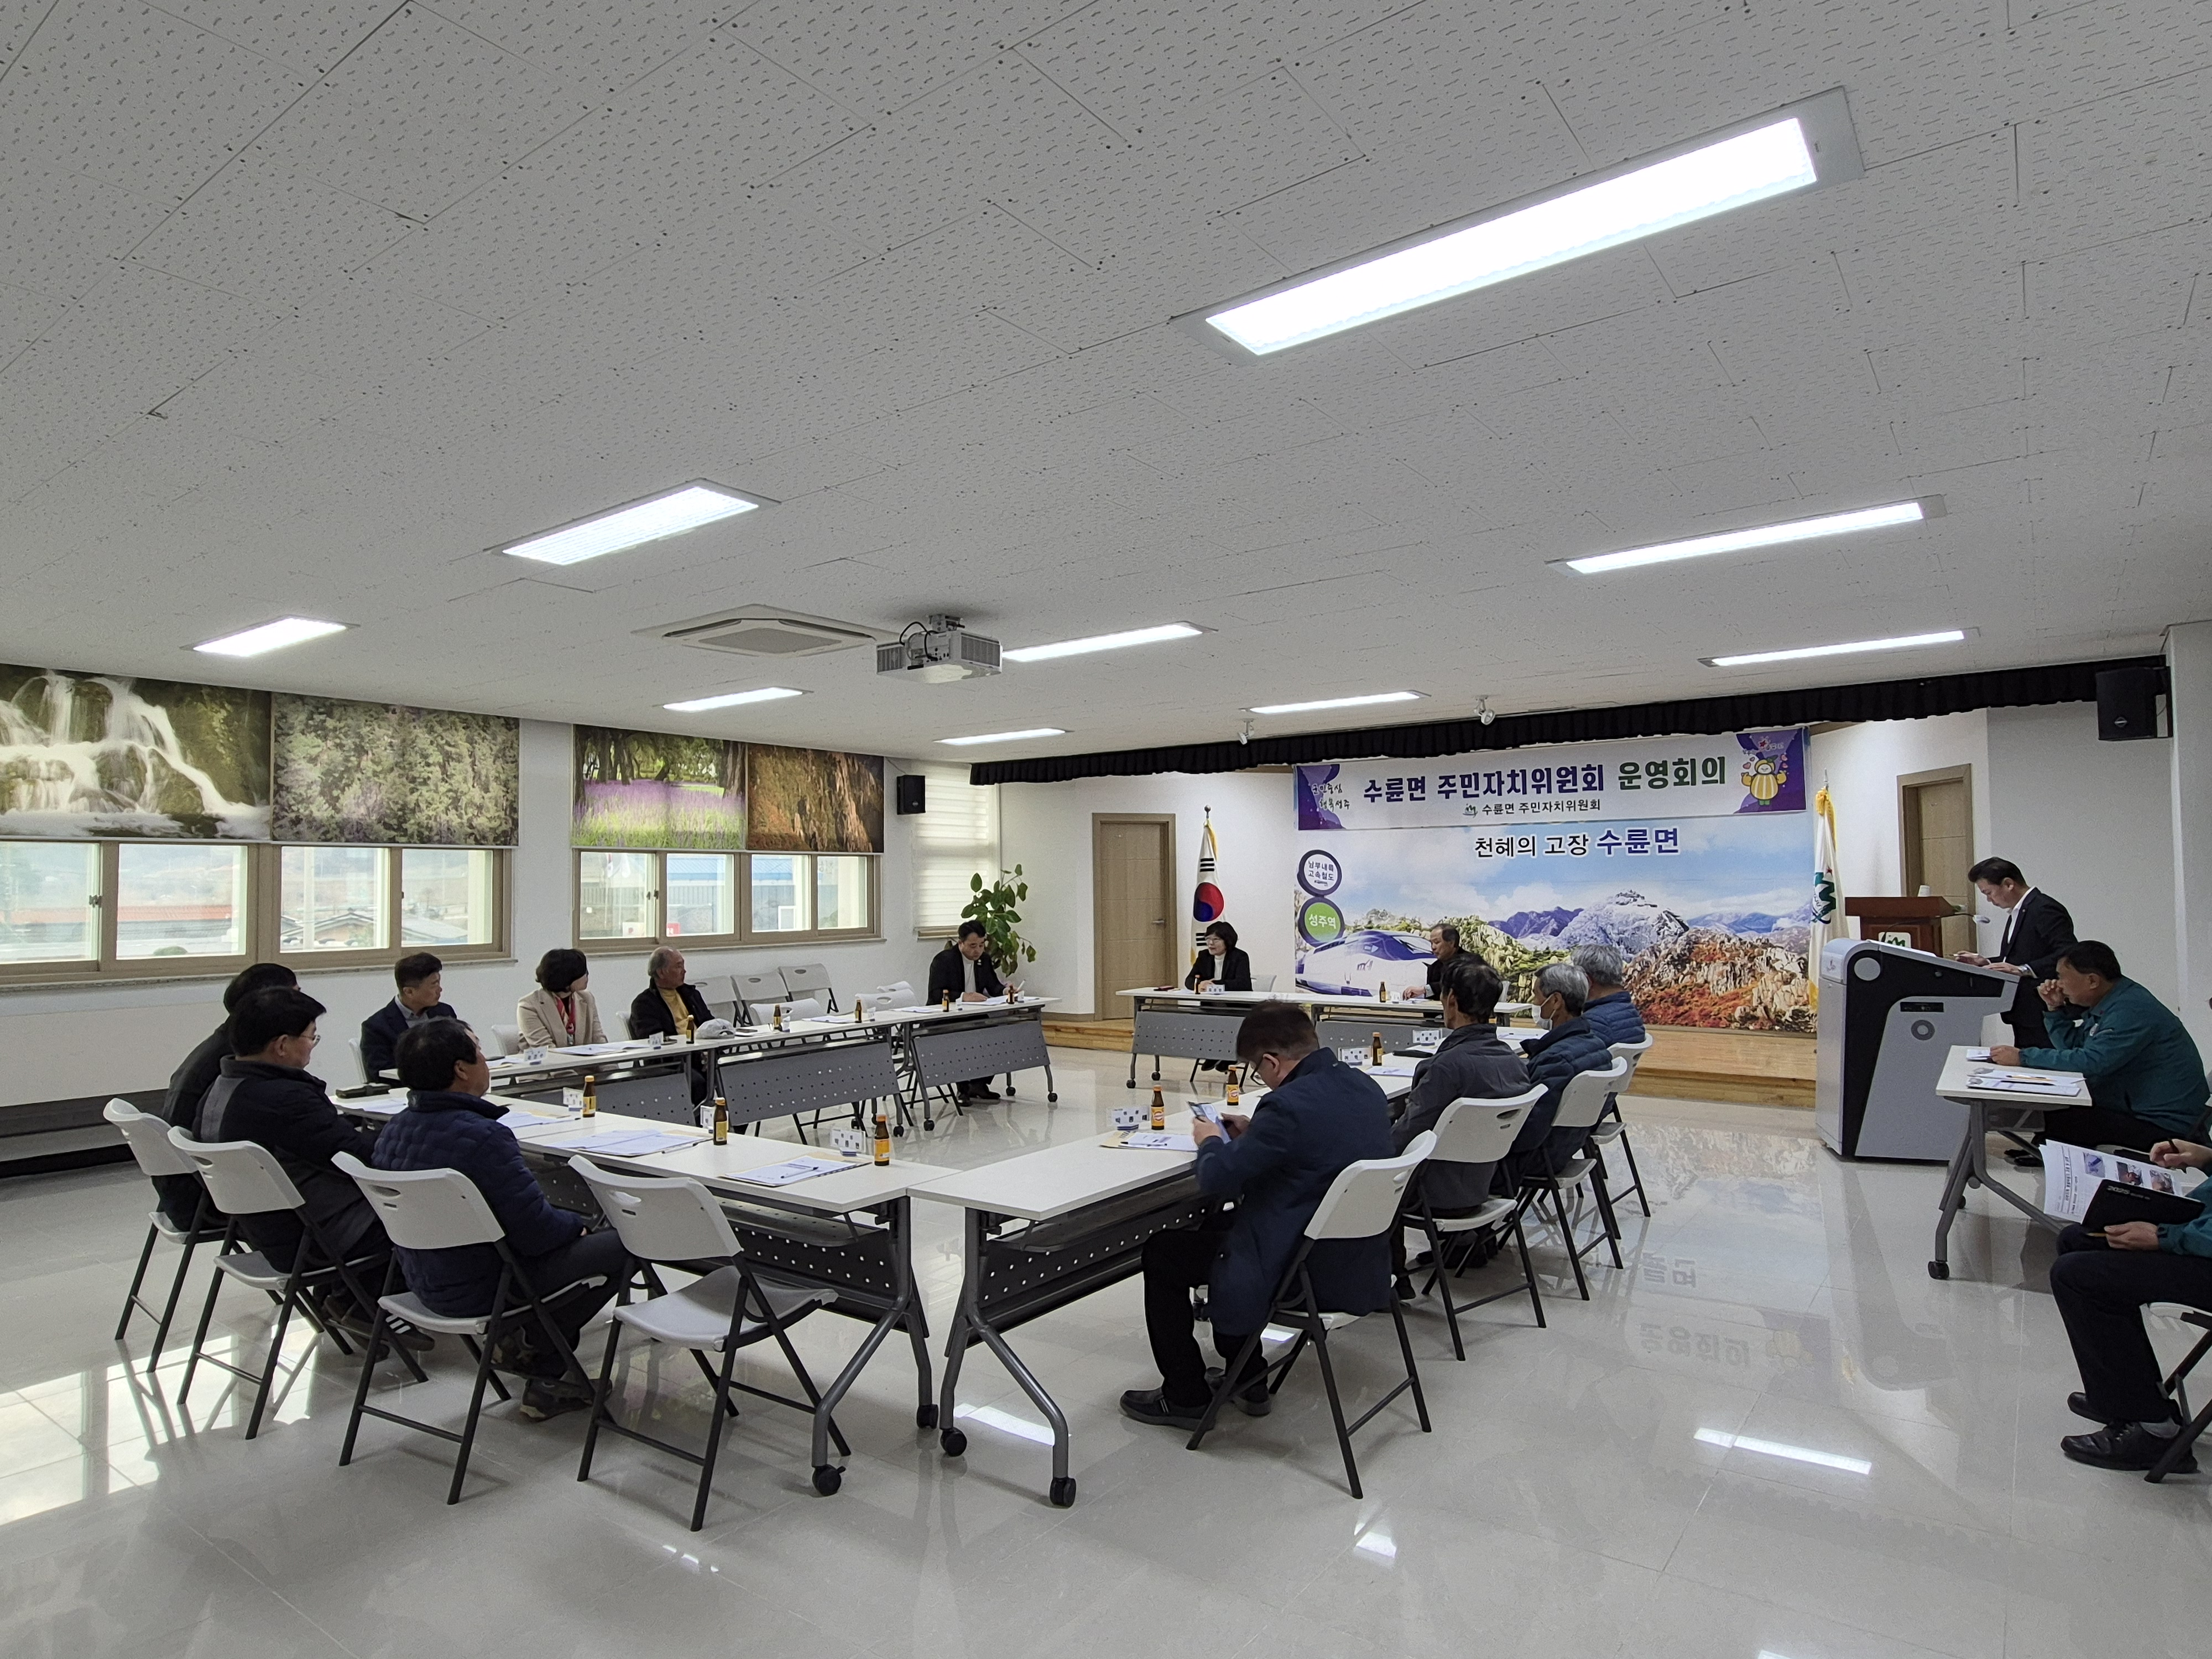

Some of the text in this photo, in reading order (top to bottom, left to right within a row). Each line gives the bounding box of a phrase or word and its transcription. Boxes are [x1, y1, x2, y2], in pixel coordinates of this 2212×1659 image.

[1364, 756, 1725, 802] 수륜면 주민자치위원회 운영회의
[1482, 799, 1600, 816] 수륜면 주민자치위원회
[1475, 828, 1679, 858] 천혜의 고장 수륜면
[1308, 914, 1337, 930] 성주역
